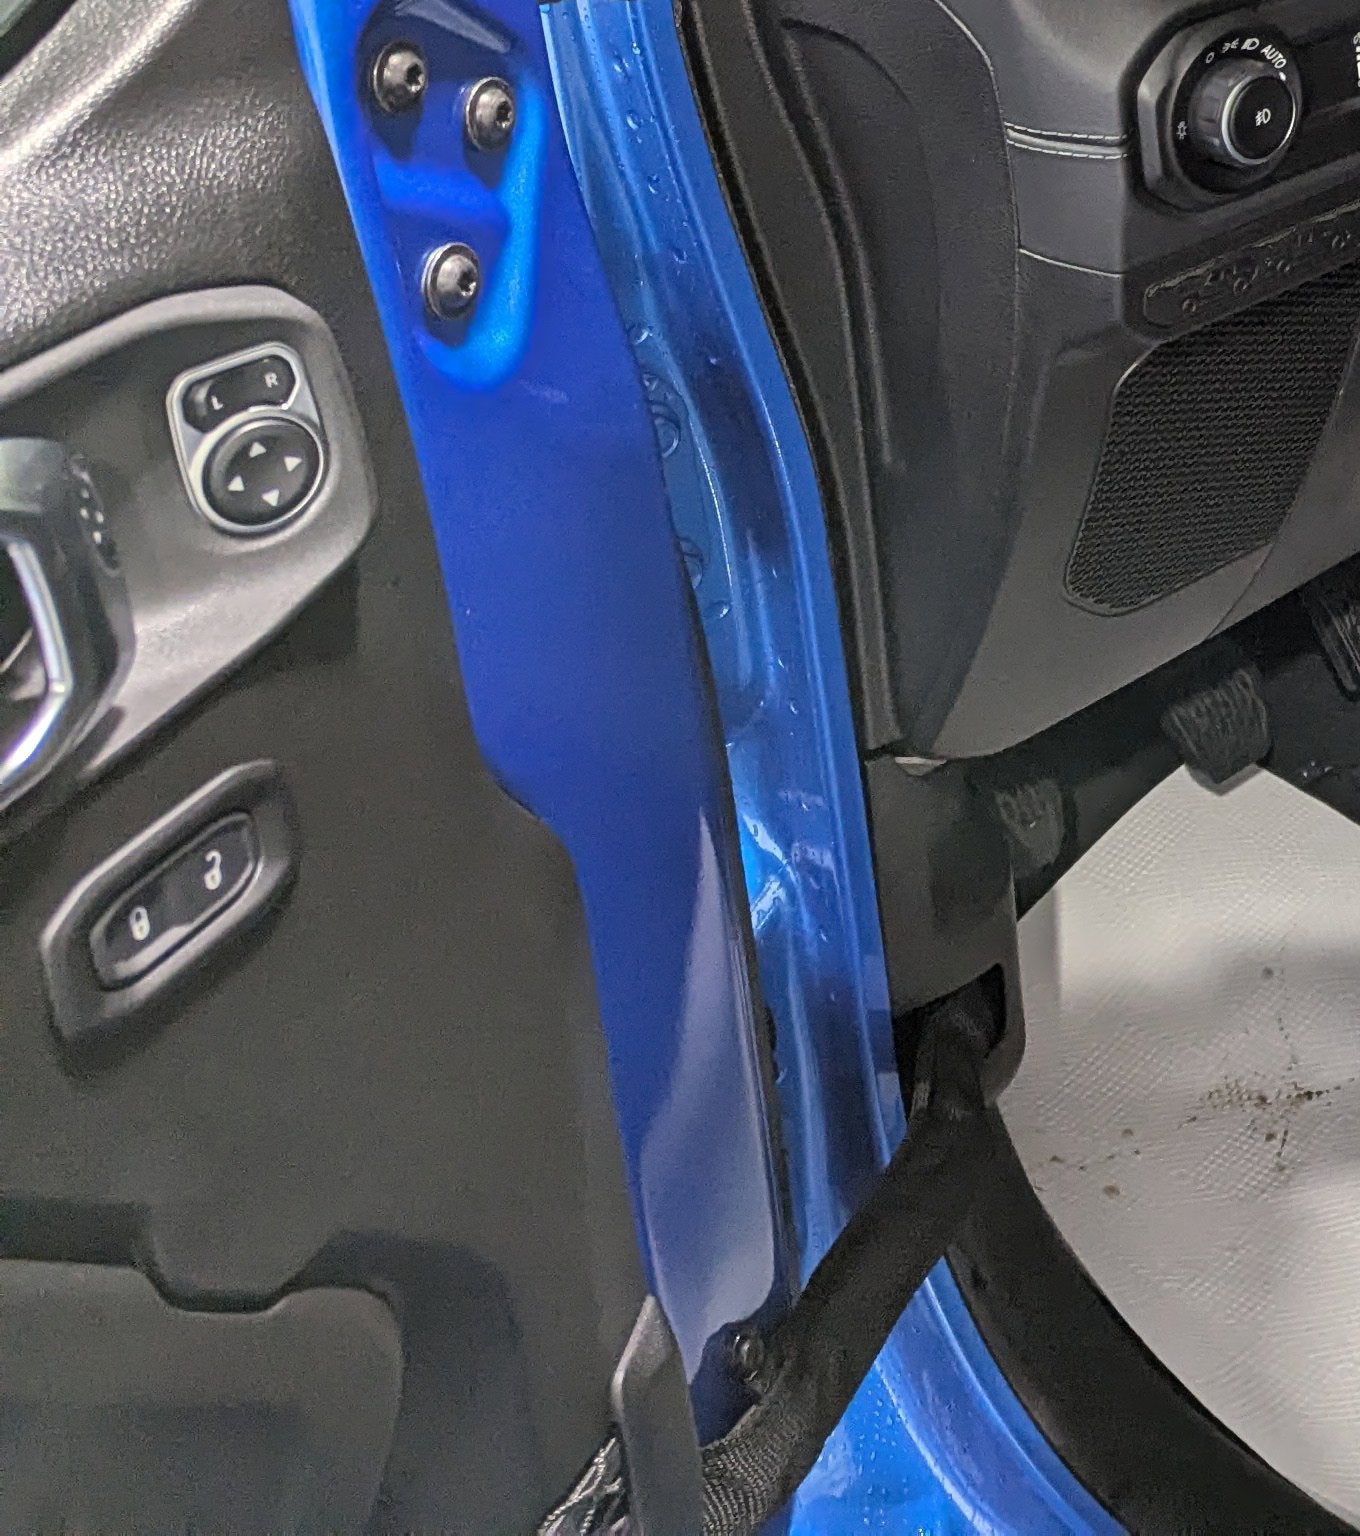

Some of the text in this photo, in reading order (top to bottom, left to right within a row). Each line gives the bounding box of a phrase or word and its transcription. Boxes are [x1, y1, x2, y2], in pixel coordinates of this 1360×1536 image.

[1260, 44, 1287, 69] AUTO
[264, 372, 278, 388] R
[211, 395, 223, 411] L
